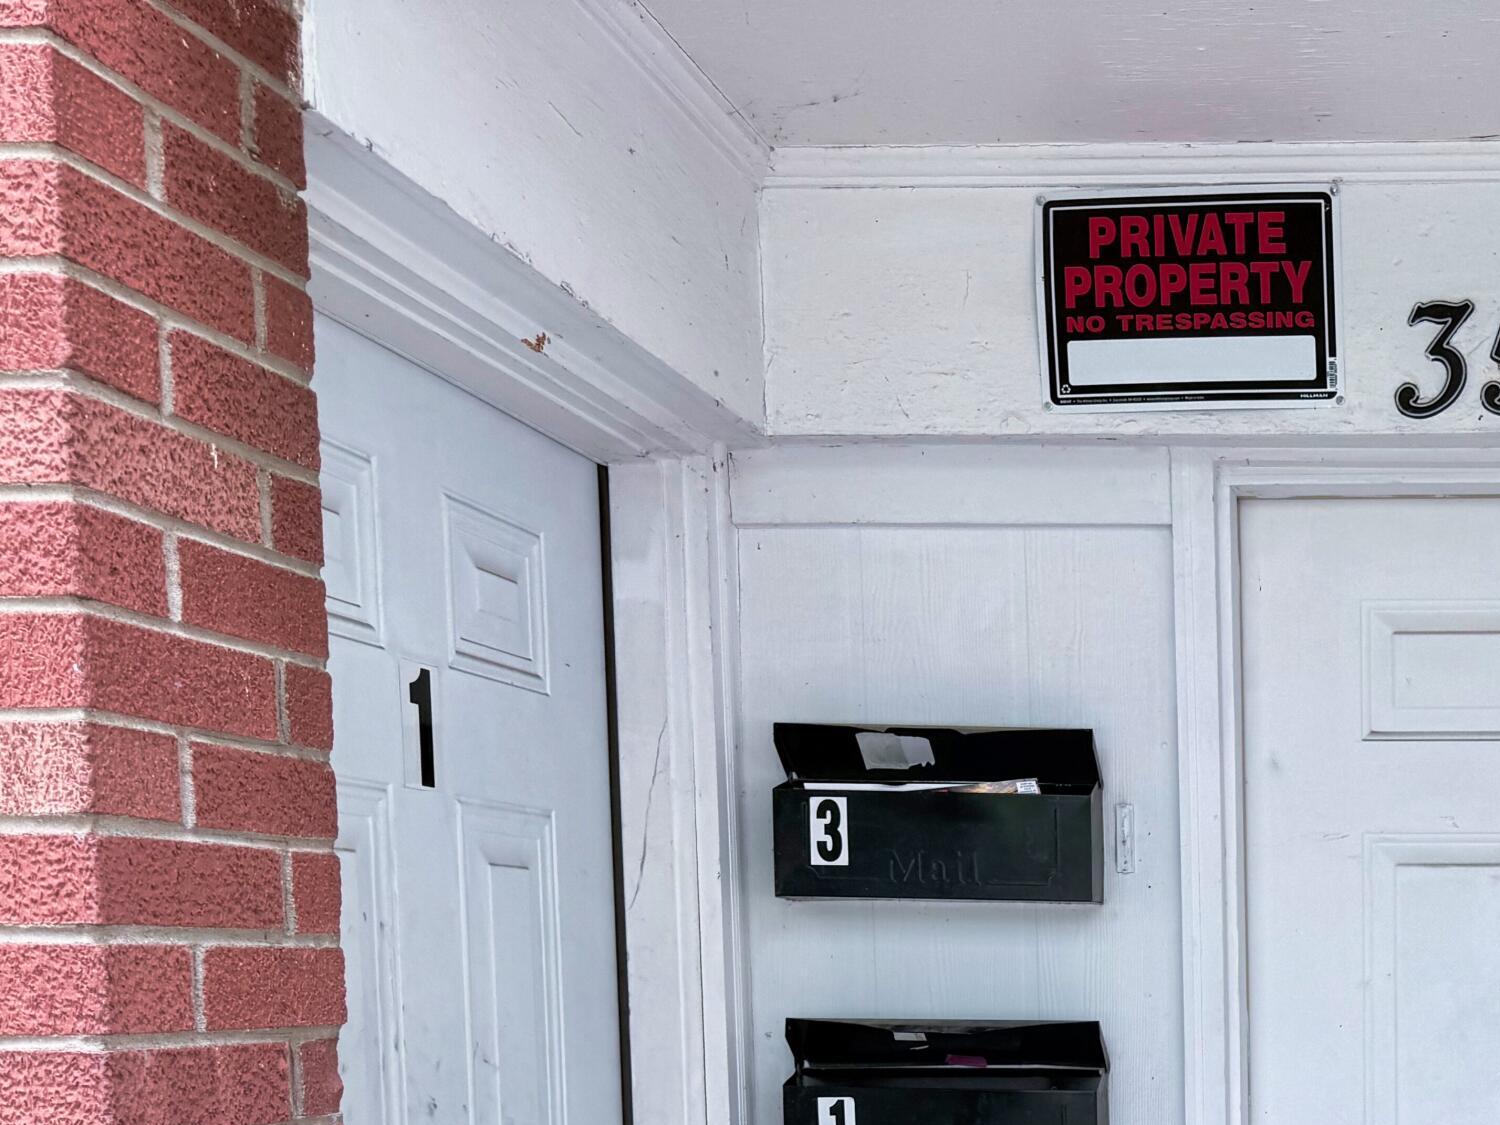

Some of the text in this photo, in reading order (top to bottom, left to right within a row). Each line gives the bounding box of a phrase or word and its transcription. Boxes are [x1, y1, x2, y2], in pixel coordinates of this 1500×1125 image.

[1088, 210, 1287, 259] PRIVATE
[1063, 260, 1313, 310] PROPERTY
[1065, 310, 1316, 334] NO TRESPASSING
[408, 667, 436, 789] 1
[815, 798, 843, 863] 3
[887, 848, 983, 887] Mail
